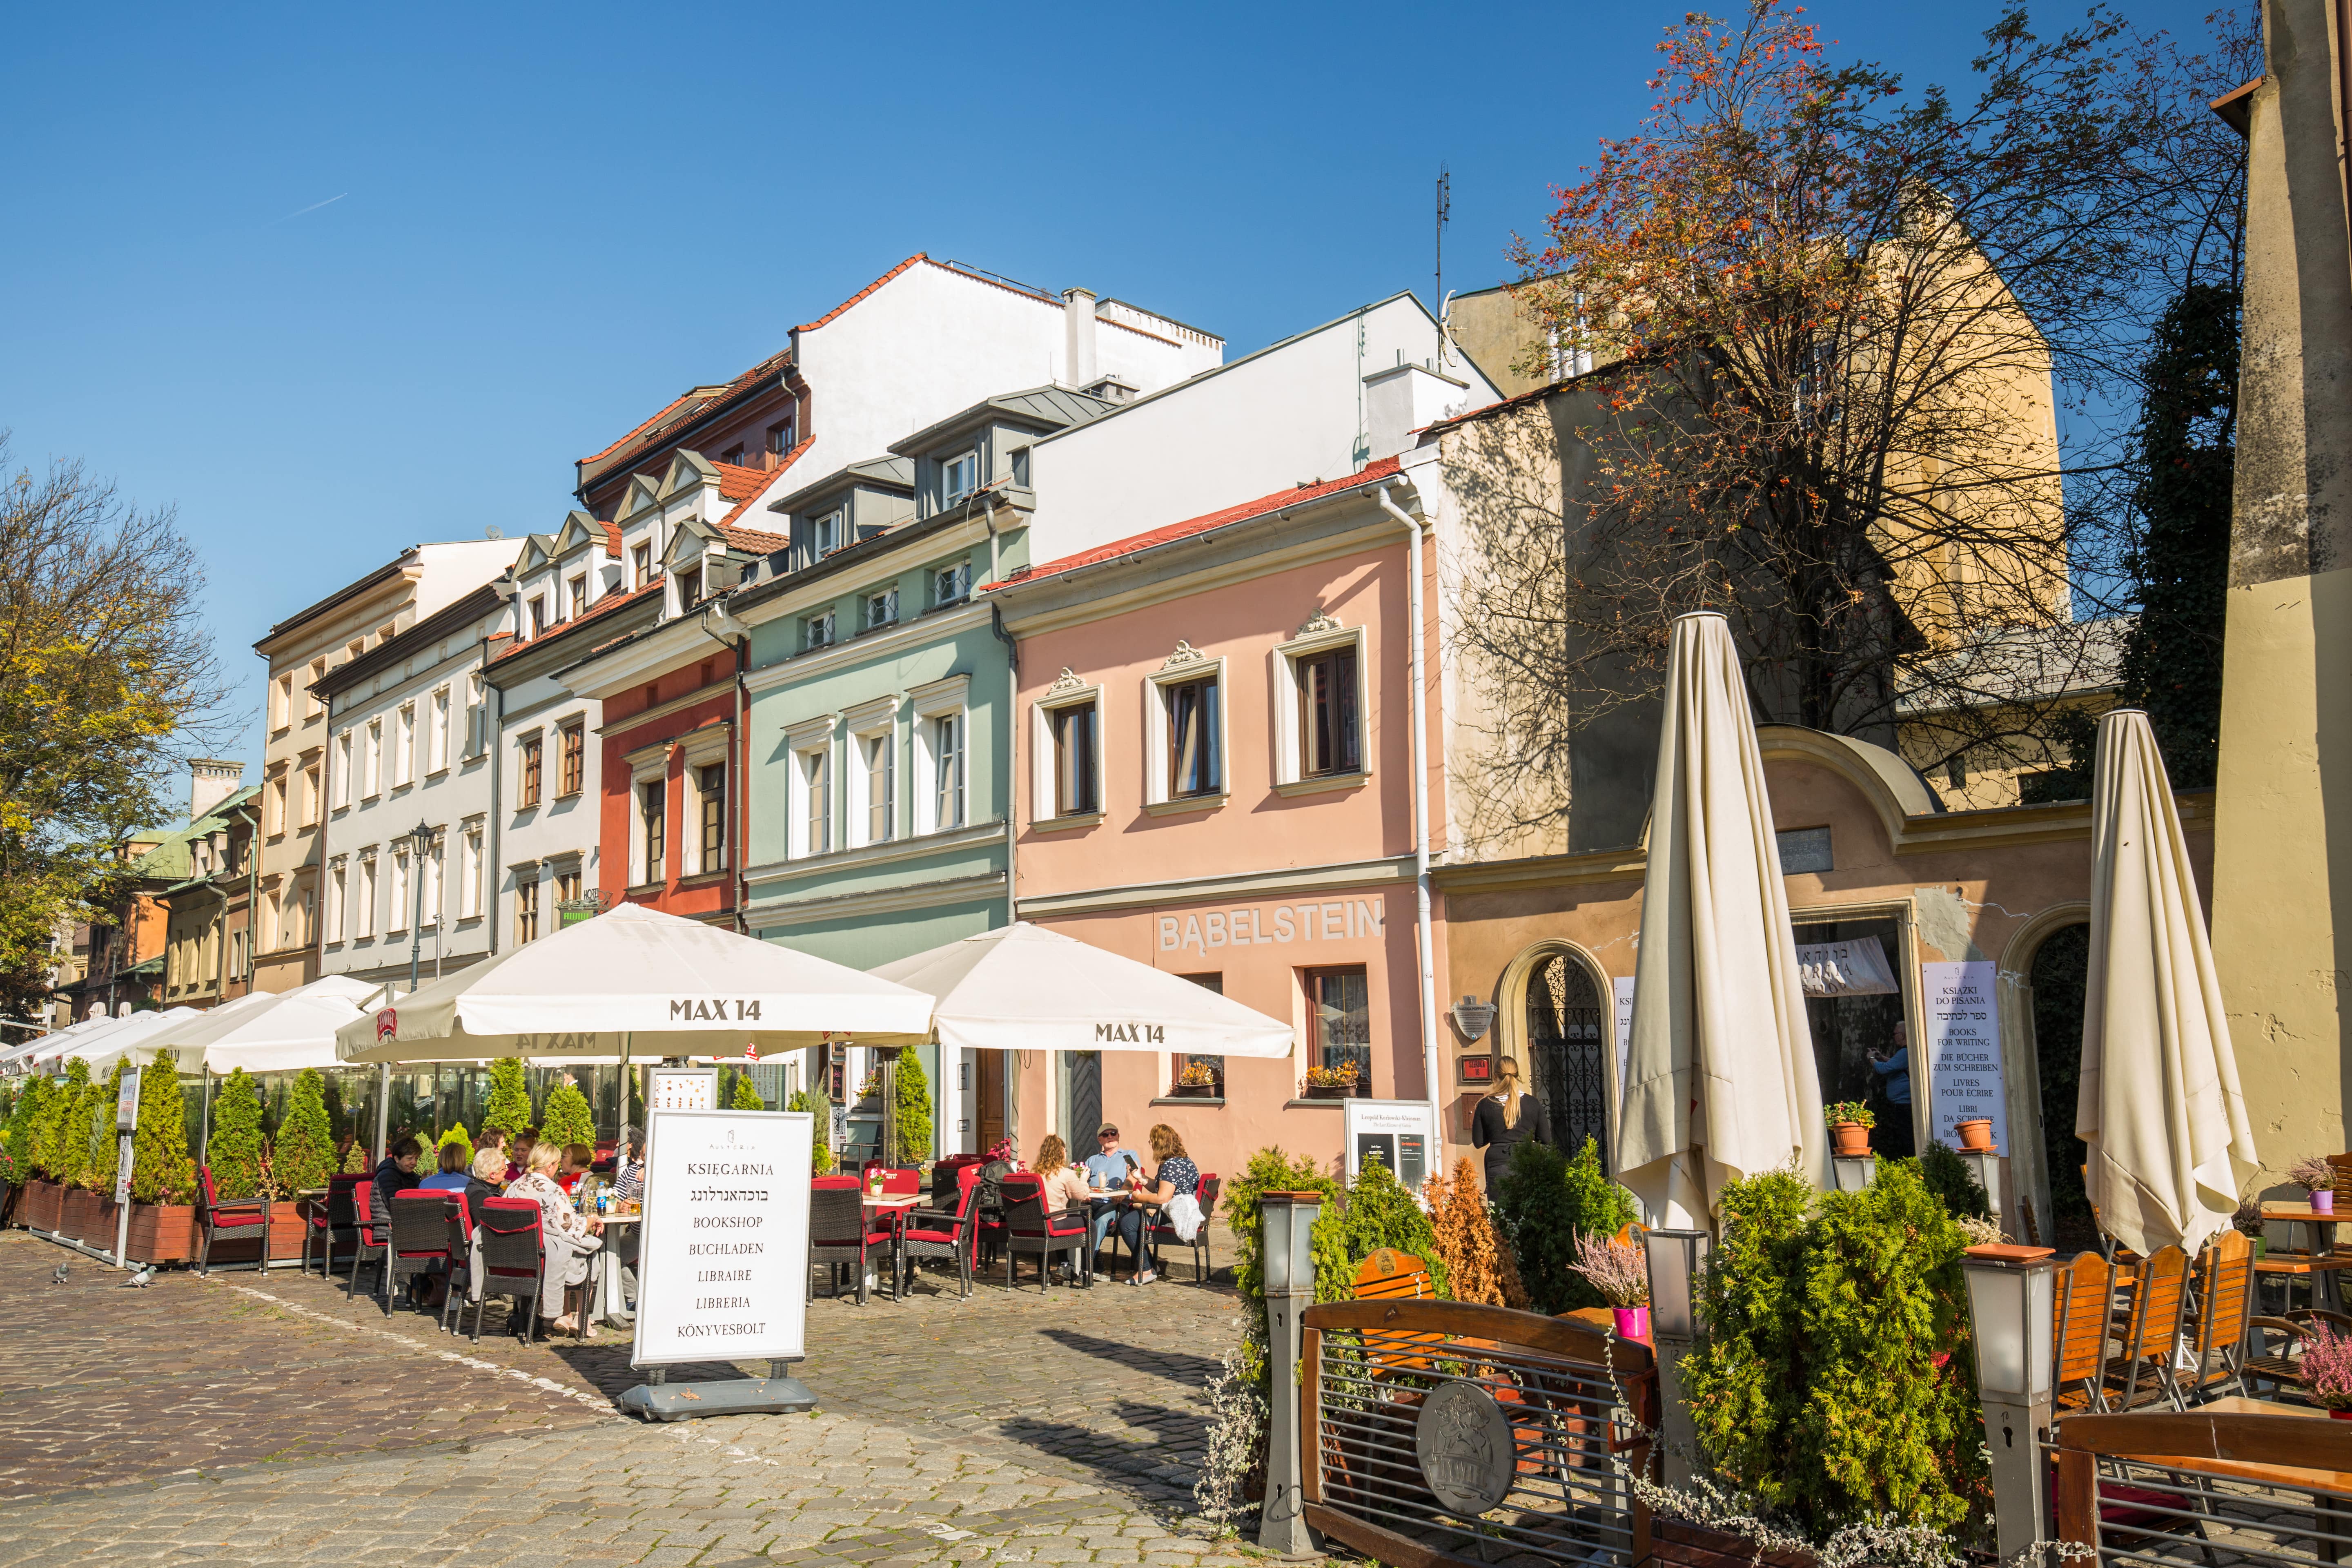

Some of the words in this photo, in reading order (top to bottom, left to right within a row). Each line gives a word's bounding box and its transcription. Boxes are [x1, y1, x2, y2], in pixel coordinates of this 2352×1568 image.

[1160, 898, 1383, 958] BĄBELSTEIN
[1943, 985, 1977, 996] KSIĄŻKI
[670, 1000, 728, 1020] MAX
[735, 1000, 762, 1020] 14
[1096, 1023, 1140, 1042] MAX
[1145, 1025, 1165, 1043] 14
[1956, 1053, 1989, 1061] BÜCHER
[1966, 1088, 1993, 1097] ÉCRIRE
[688, 1163, 773, 1177] KSIĘGARNIA
[690, 1186, 768, 1201] בוכהאנרלונג
[694, 1216, 763, 1228] BOOKSHOP
[689, 1243, 764, 1255] BUCHLADEN
[698, 1270, 752, 1282] LIBRAIRE
[696, 1297, 750, 1309] LIBRERIA
[678, 1323, 766, 1337] KÖNYVESBOLT
